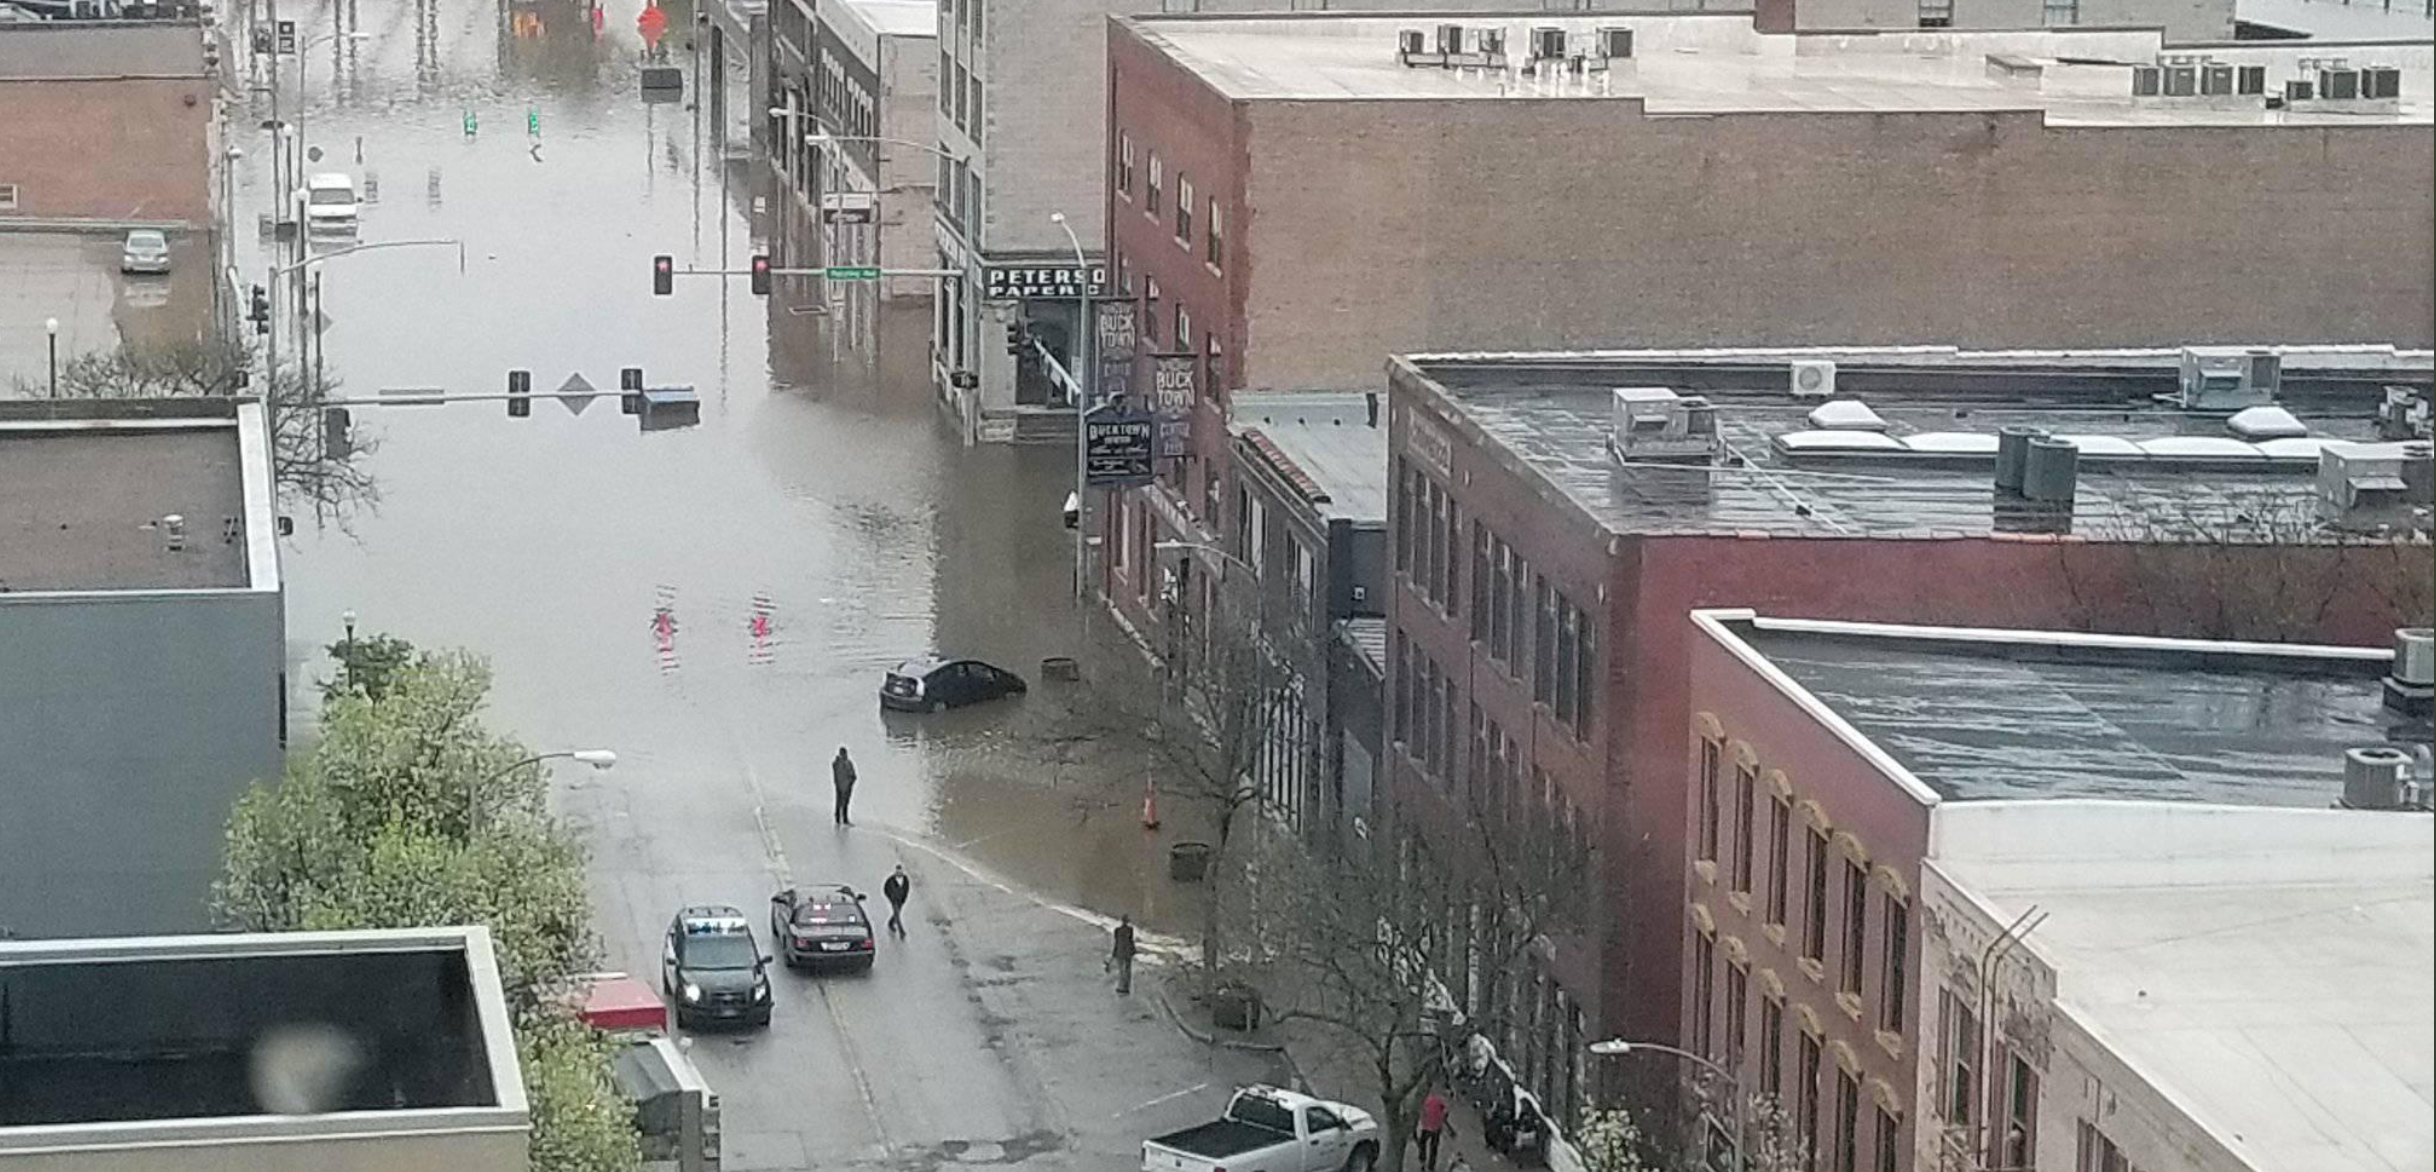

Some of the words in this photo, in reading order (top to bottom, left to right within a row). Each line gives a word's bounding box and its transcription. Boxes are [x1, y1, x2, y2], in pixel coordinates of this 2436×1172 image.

[1101, 313, 1135, 331] BUCK
[1101, 331, 1136, 349] TOWN
[1156, 371, 1194, 390] BUCK
[1157, 389, 1196, 406] TOWN
[1089, 423, 1151, 441] BUCKTOWN
